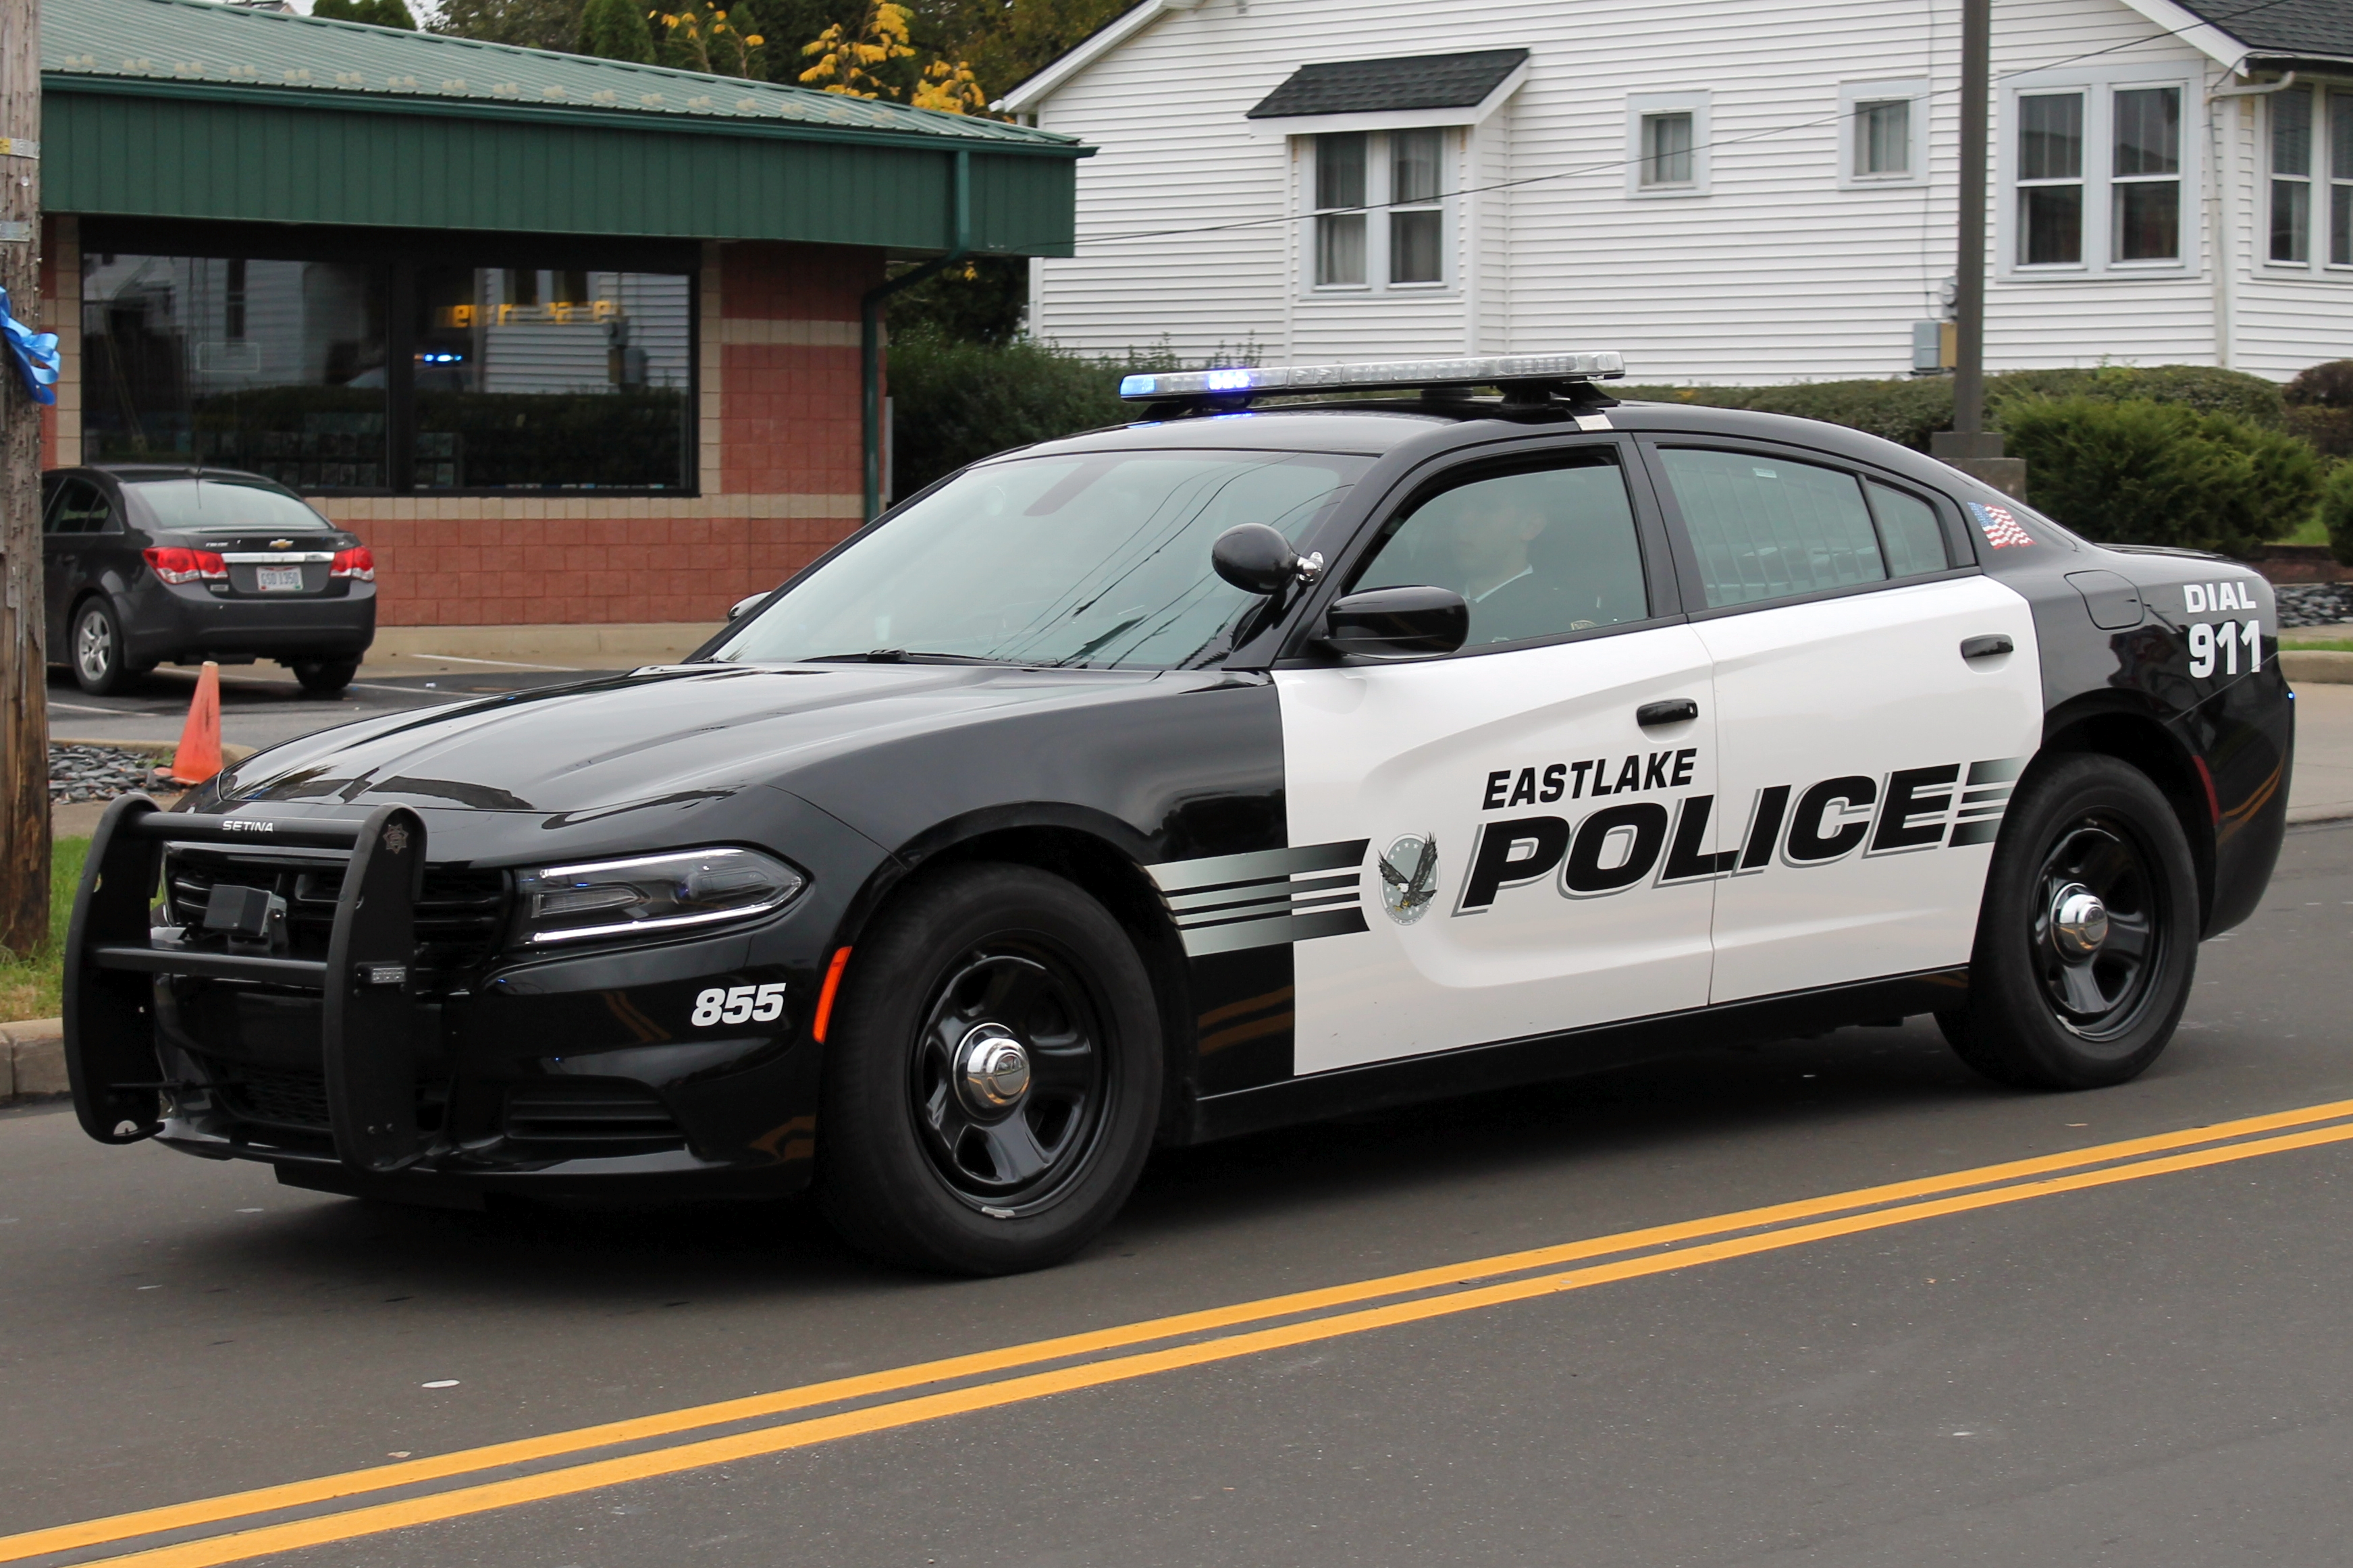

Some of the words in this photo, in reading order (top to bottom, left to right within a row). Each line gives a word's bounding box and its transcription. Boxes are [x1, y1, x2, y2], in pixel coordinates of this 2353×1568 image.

[2183, 581, 2256, 613] DIAL
[2188, 620, 2261, 678] 911
[1482, 748, 1697, 810] EASTLAKE
[222, 820, 273, 832] SETINA
[1452, 763, 1961, 917] POLICE
[691, 983, 787, 1027] 855
